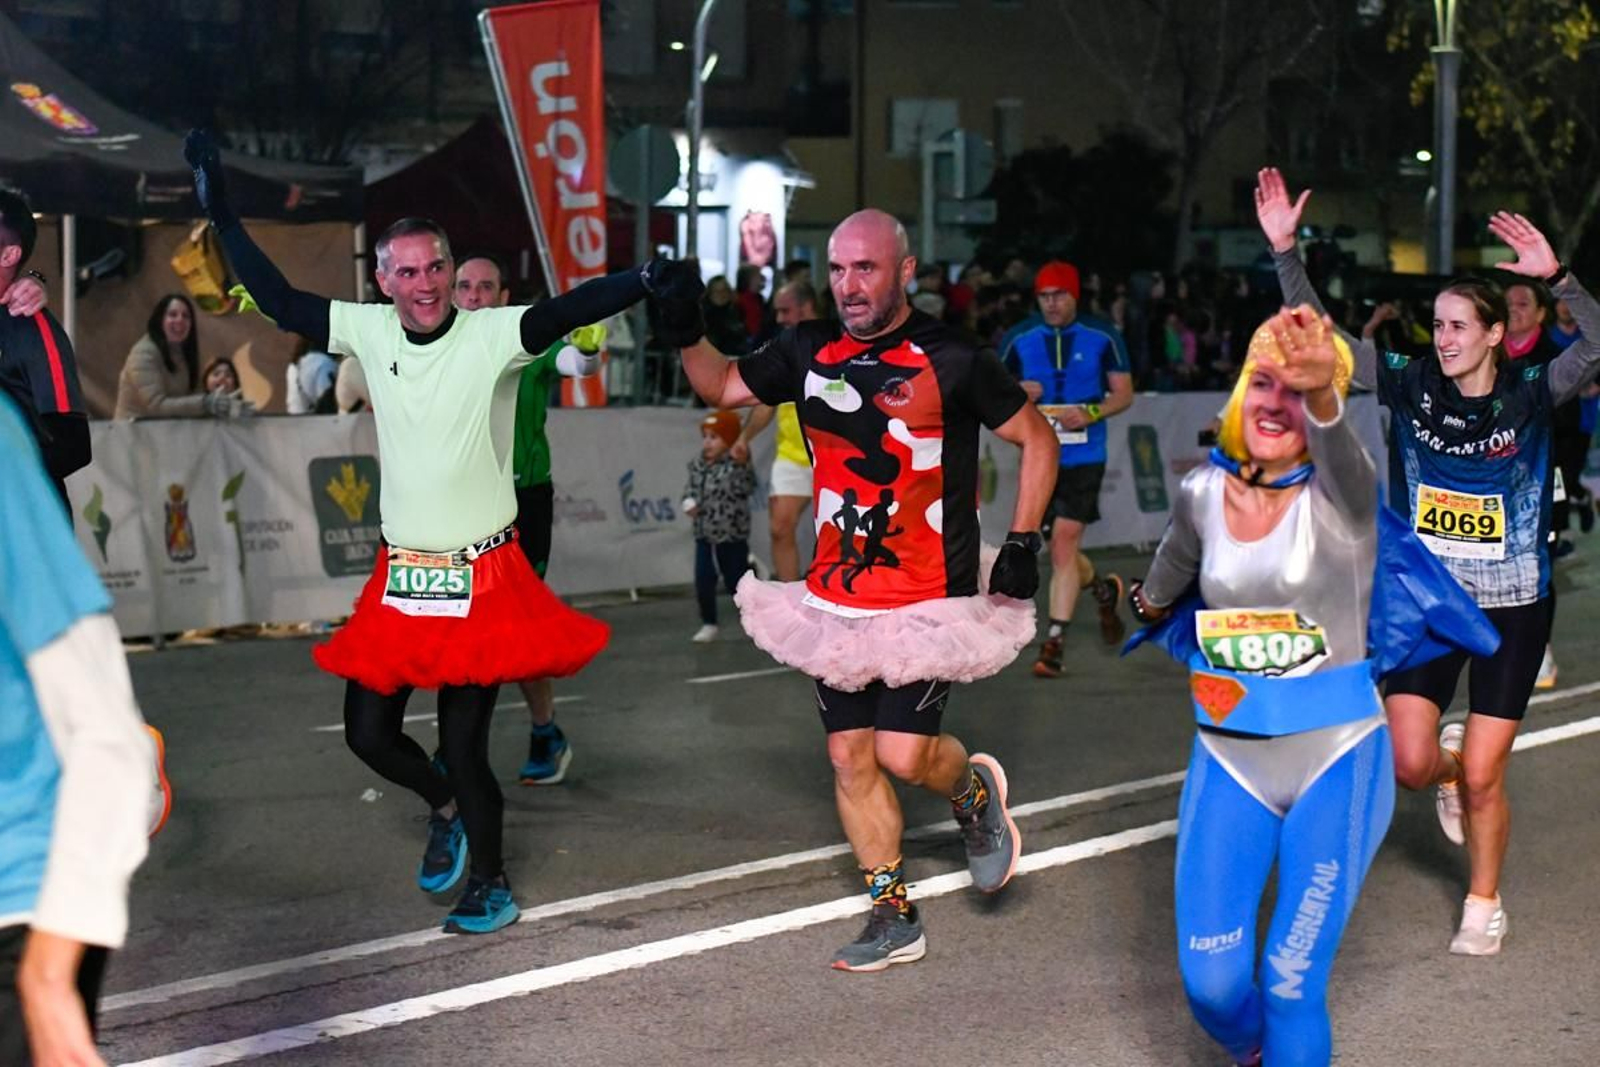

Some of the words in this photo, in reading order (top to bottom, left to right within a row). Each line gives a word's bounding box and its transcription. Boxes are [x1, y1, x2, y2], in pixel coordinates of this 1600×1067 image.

[1423, 507, 1496, 536] 4069
[395, 567, 465, 593] 1025
[1189, 926, 1243, 951] land
